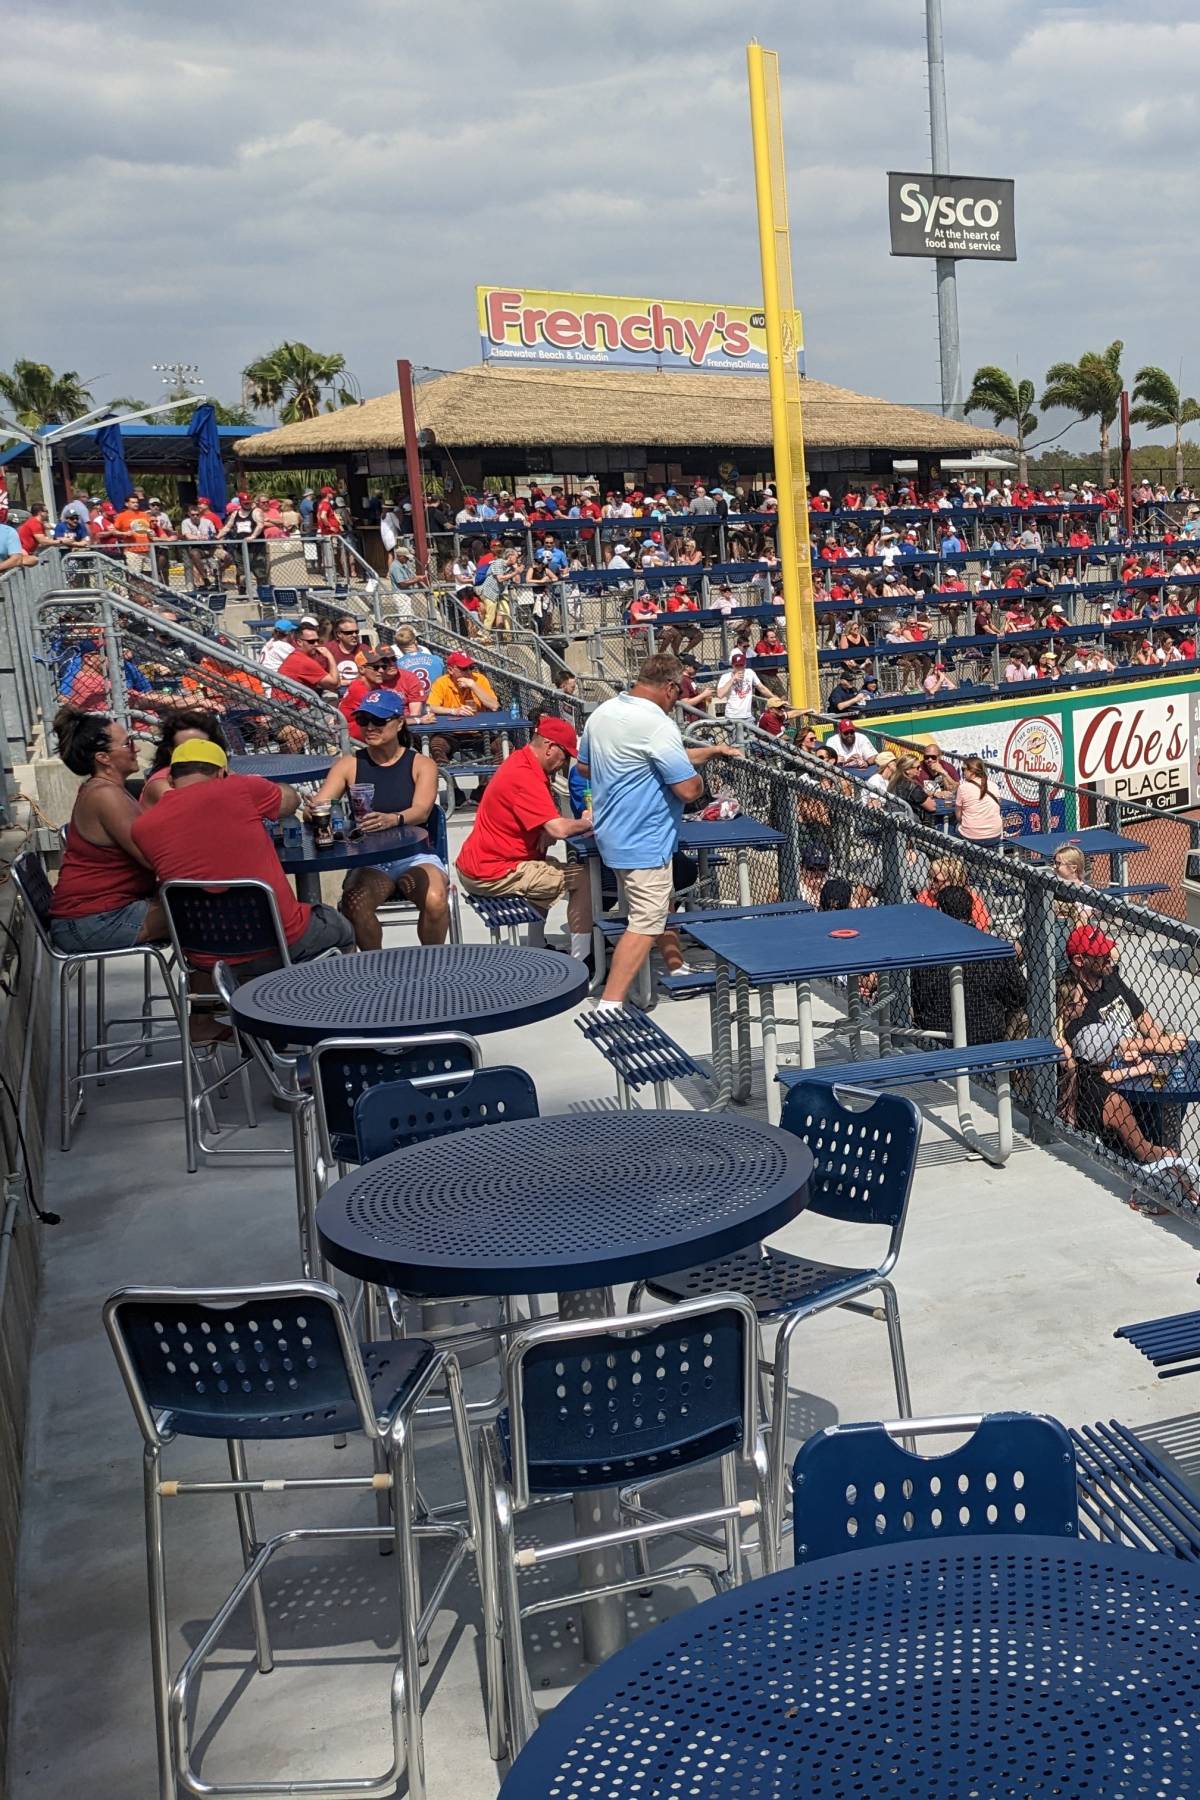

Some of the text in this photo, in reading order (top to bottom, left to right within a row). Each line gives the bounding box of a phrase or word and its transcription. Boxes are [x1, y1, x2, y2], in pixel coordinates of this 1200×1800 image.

[934, 228, 1000, 241] At the heart of
[925, 238, 1001, 251] food and service
[487, 291, 751, 366] Frenchy's
[490, 348, 609, 363] Clearwater Beach & Dunedin
[706, 359, 770, 369] FrenchysOnline.co
[1078, 704, 1189, 780] Abe's
[981, 744, 999, 760] the
[1012, 749, 1058, 774] Phillies
[1115, 768, 1180, 797] PLACE
[1156, 794, 1177, 808] Grill
